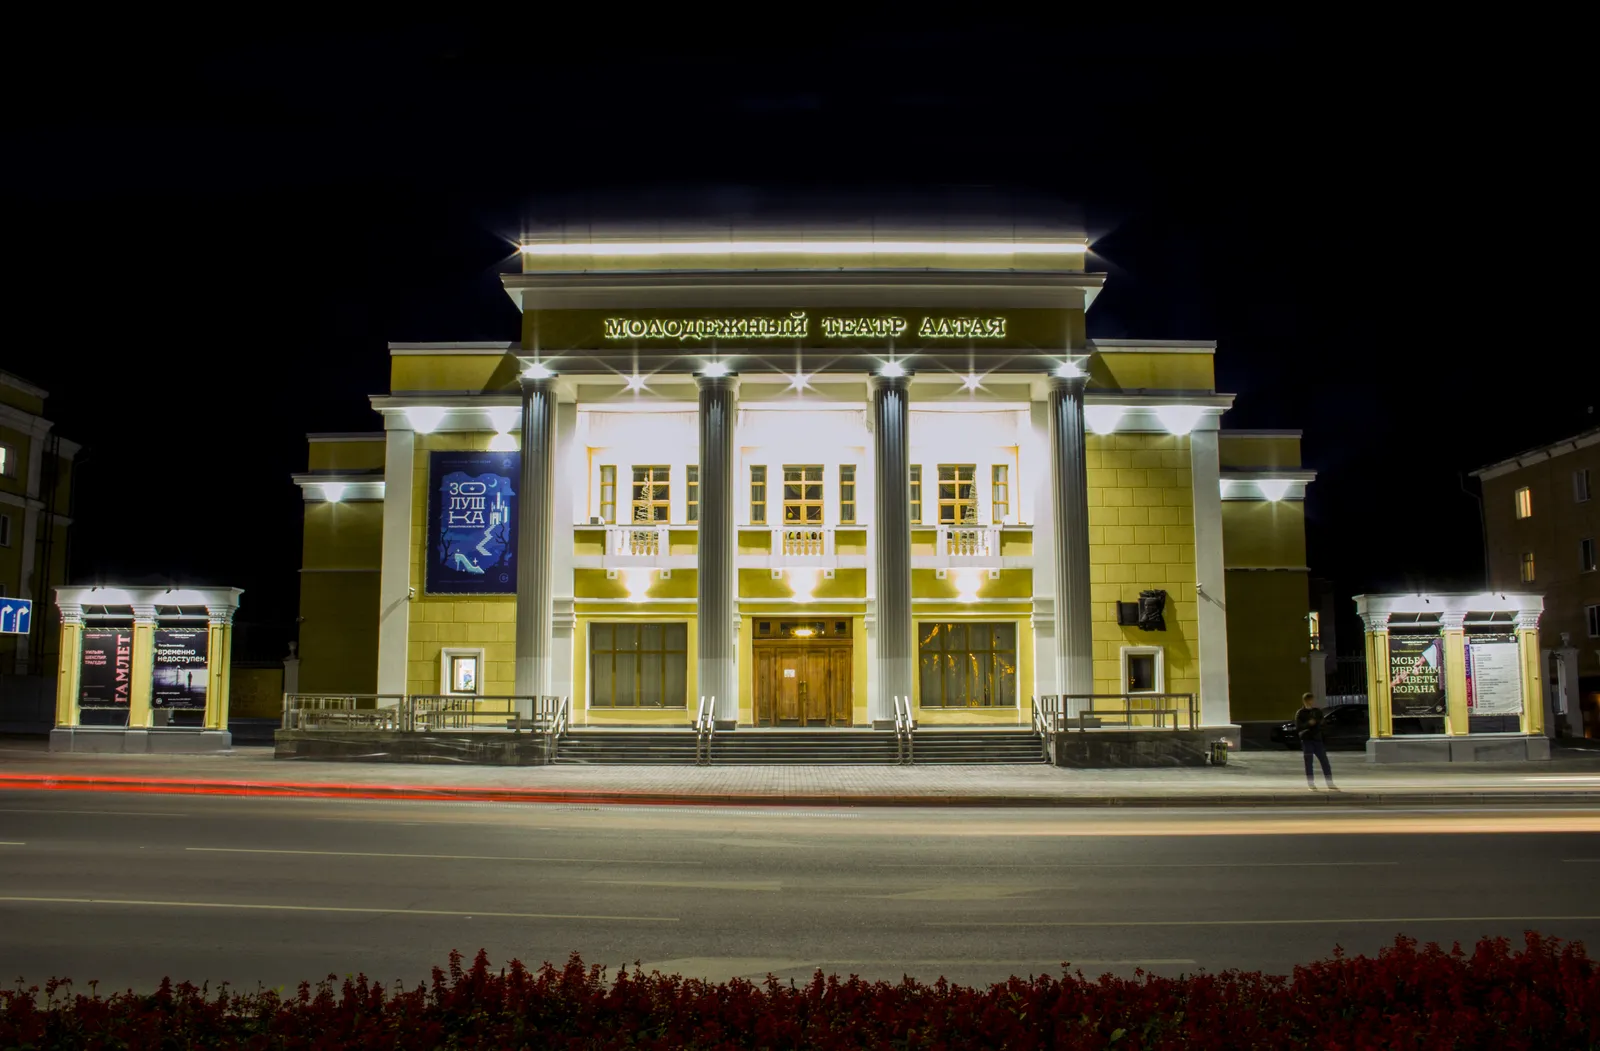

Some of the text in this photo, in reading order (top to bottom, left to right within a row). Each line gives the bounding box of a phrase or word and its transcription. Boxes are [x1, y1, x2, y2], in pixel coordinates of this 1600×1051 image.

[604, 312, 1006, 339] МОЛОДЕЖНЫЙ ТЕАТР АЛТАЯ
[1391, 656, 1420, 665] МСЬЕ
[115, 634, 131, 703] ГАМЛЕТ
[1403, 676, 1438, 685] ЦВЕТЫ
[1393, 685, 1436, 694] КОРАНА
